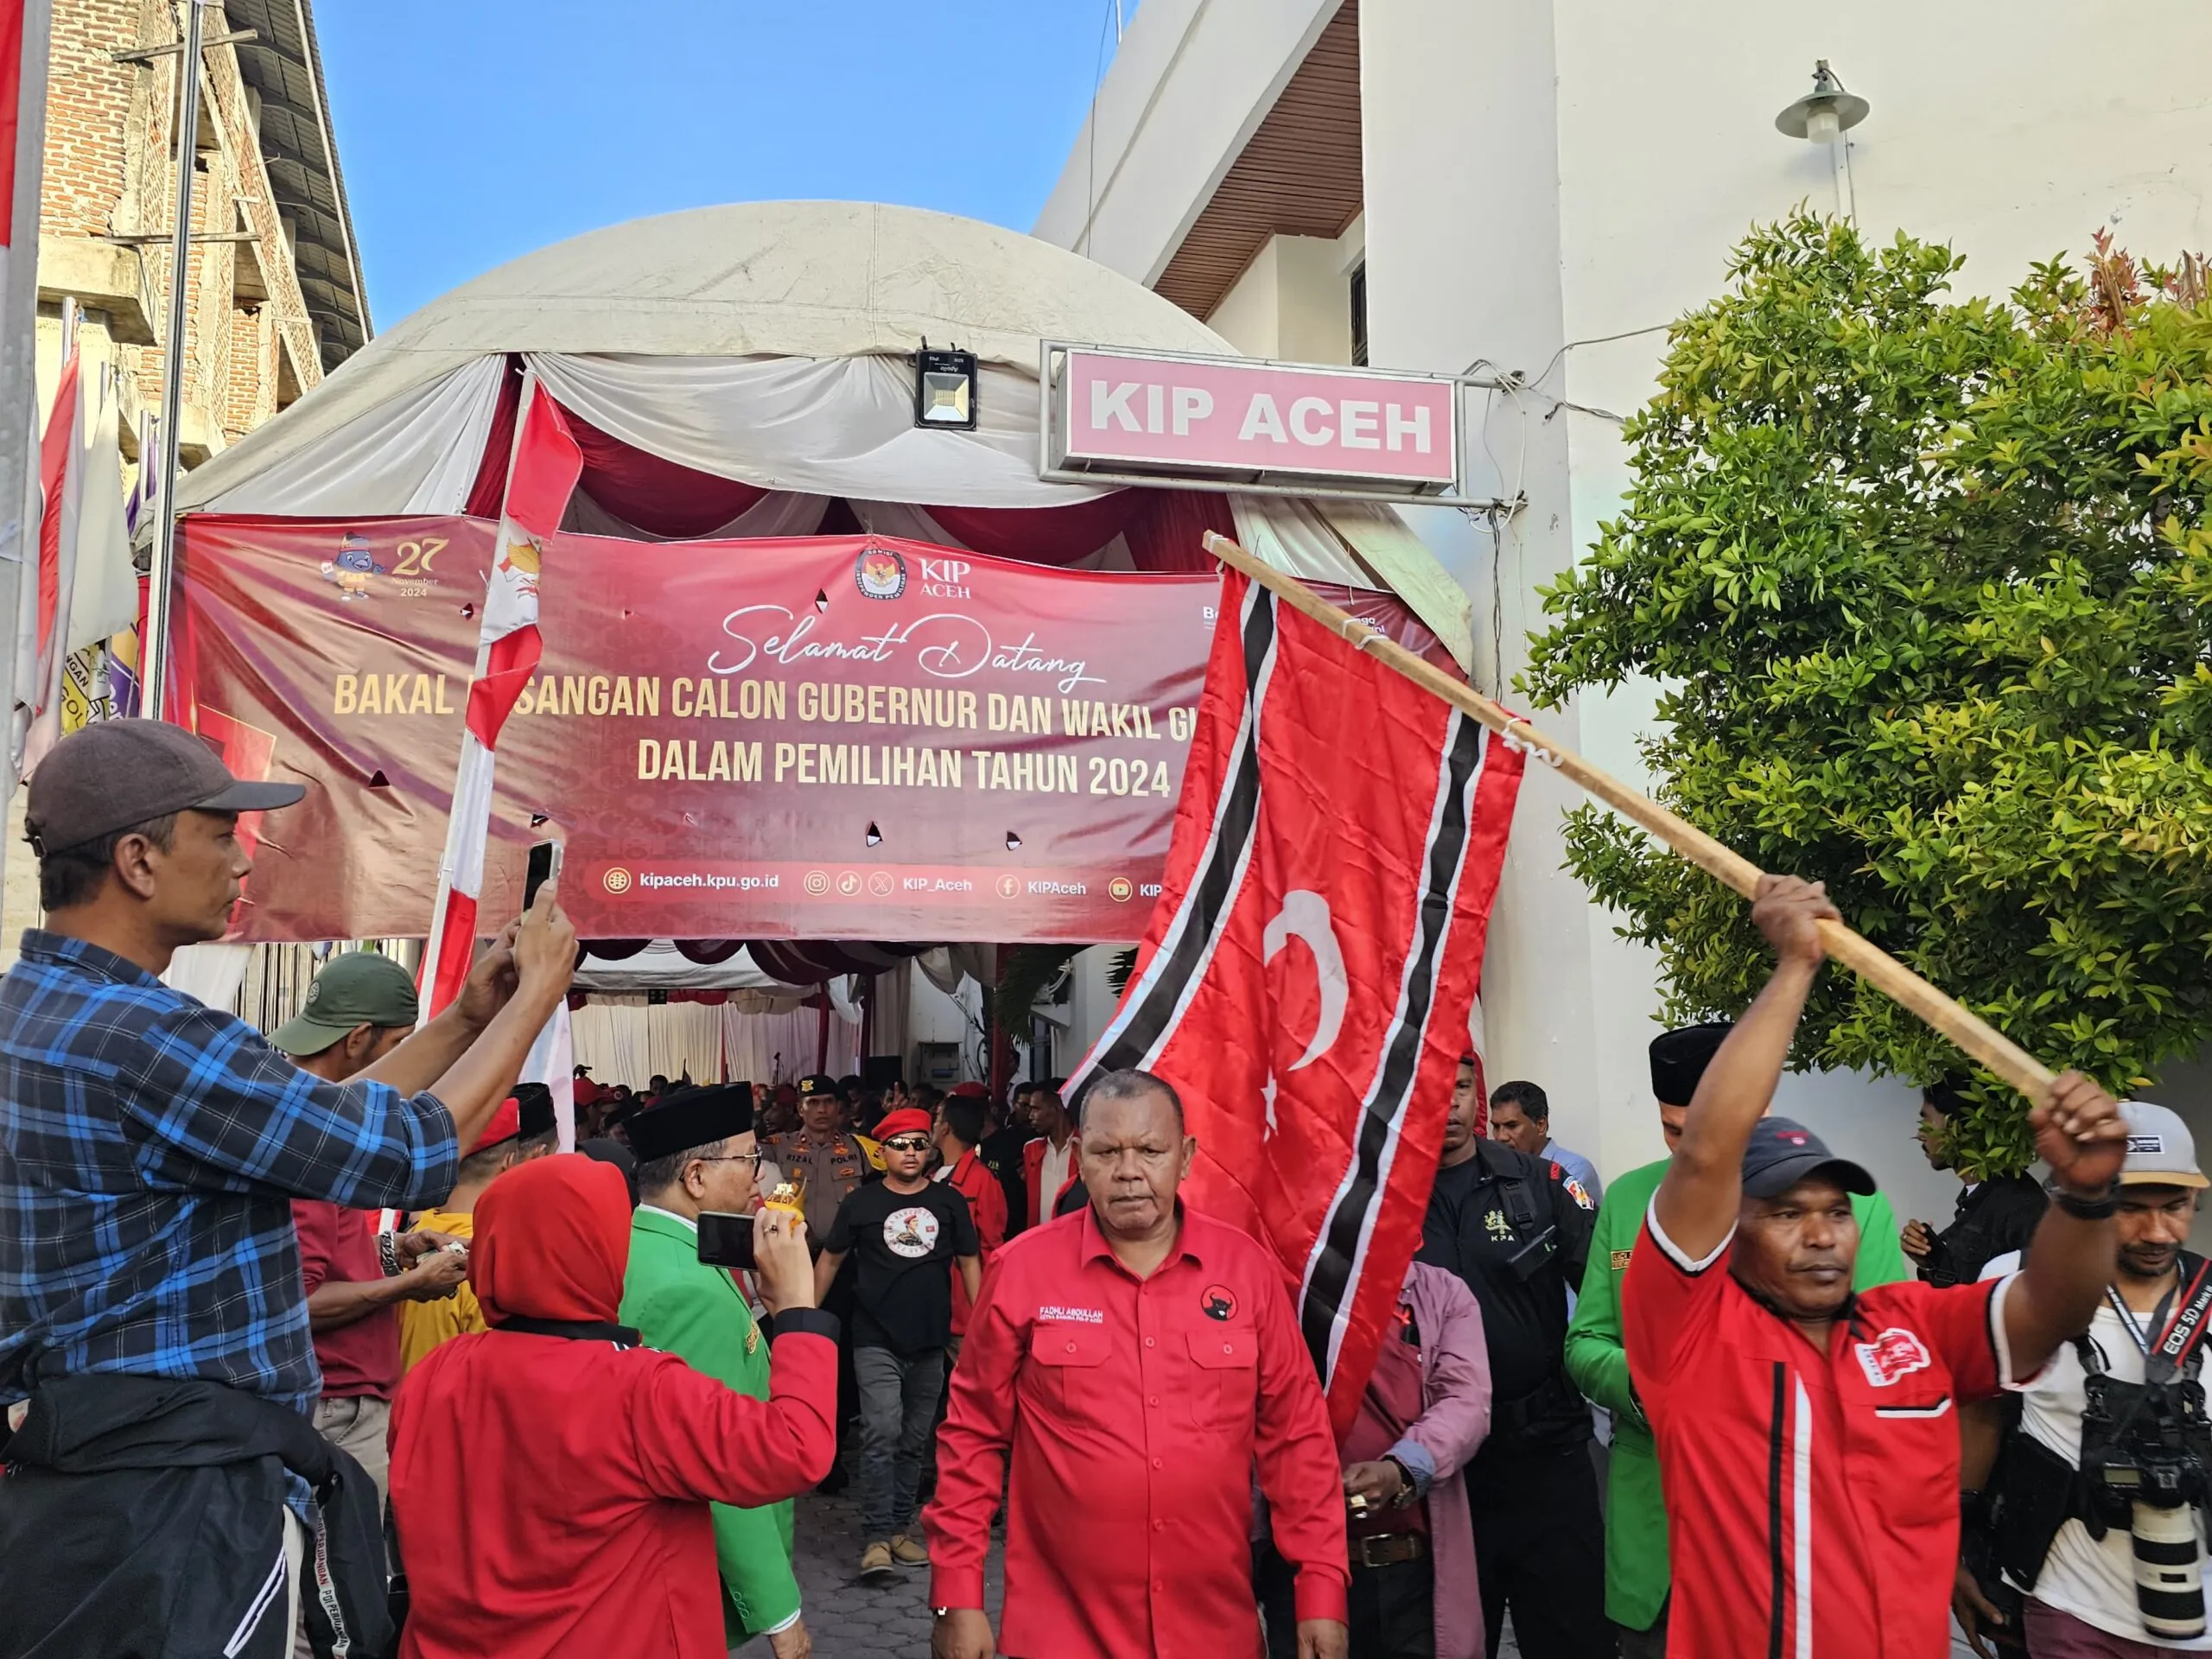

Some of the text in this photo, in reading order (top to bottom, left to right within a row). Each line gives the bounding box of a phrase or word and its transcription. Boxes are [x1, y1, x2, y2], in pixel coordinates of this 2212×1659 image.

[1090, 380, 1431, 453] KIP ACEH
[391, 537, 449, 575] 27
[919, 557, 971, 583] KIP
[391, 577, 439, 586] November
[400, 588, 428, 597] 2024
[920, 582, 972, 599] ACEH
[708, 605, 1106, 694] Selamat Datang
[334, 674, 454, 715] BAKAL
[467, 676, 660, 716] SANGAN
[671, 678, 786, 720] CALON
[798, 682, 976, 729] GUBERNUR
[988, 693, 1052, 734] DAN
[1061, 698, 1162, 741] WAKIL
[638, 739, 1171, 798] DALAM PEMILIHAN TAHUN 2024
[639, 873, 779, 891] kipaceh.kpu.go.id
[903, 878, 972, 892] KIP_Aceh
[1027, 881, 1086, 895] KIPAceh
[786, 1154, 812, 1165] RIZAL
[830, 1154, 858, 1165] POLRI
[1065, 1307, 1103, 1319] ABDULLAH
[2163, 1323, 2191, 1355] EOS
[2180, 1307, 2201, 1326] 5D
[2194, 1291, 2212, 1311] Mark
[322, 1589, 334, 1605] PDI
